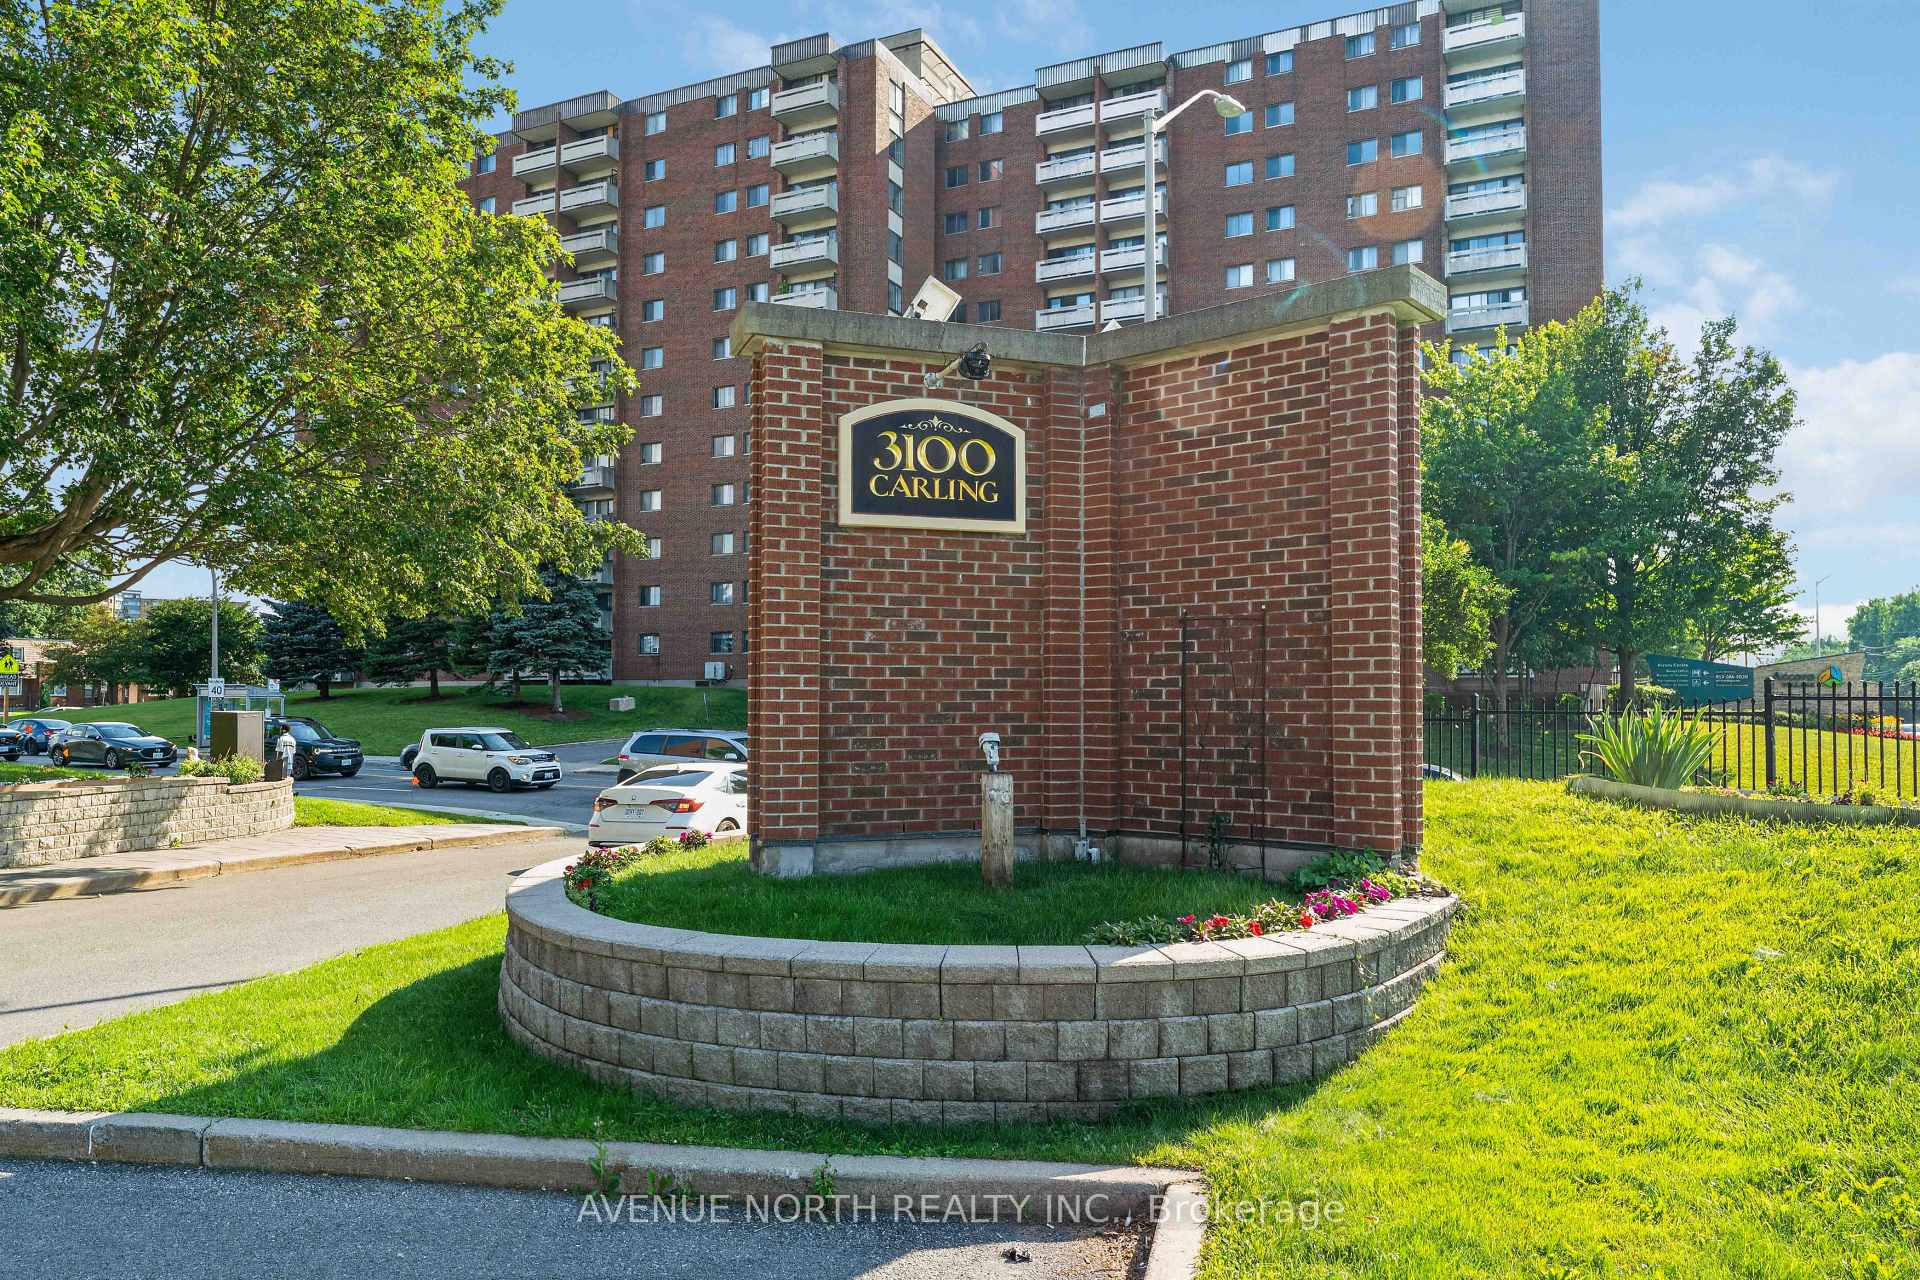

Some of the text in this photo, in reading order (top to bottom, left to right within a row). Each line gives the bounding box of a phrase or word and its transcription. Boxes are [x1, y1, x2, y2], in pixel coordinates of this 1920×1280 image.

[873, 431, 996, 476] 3100
[869, 473, 999, 503] CARLING
[211, 686, 222, 694] 40
